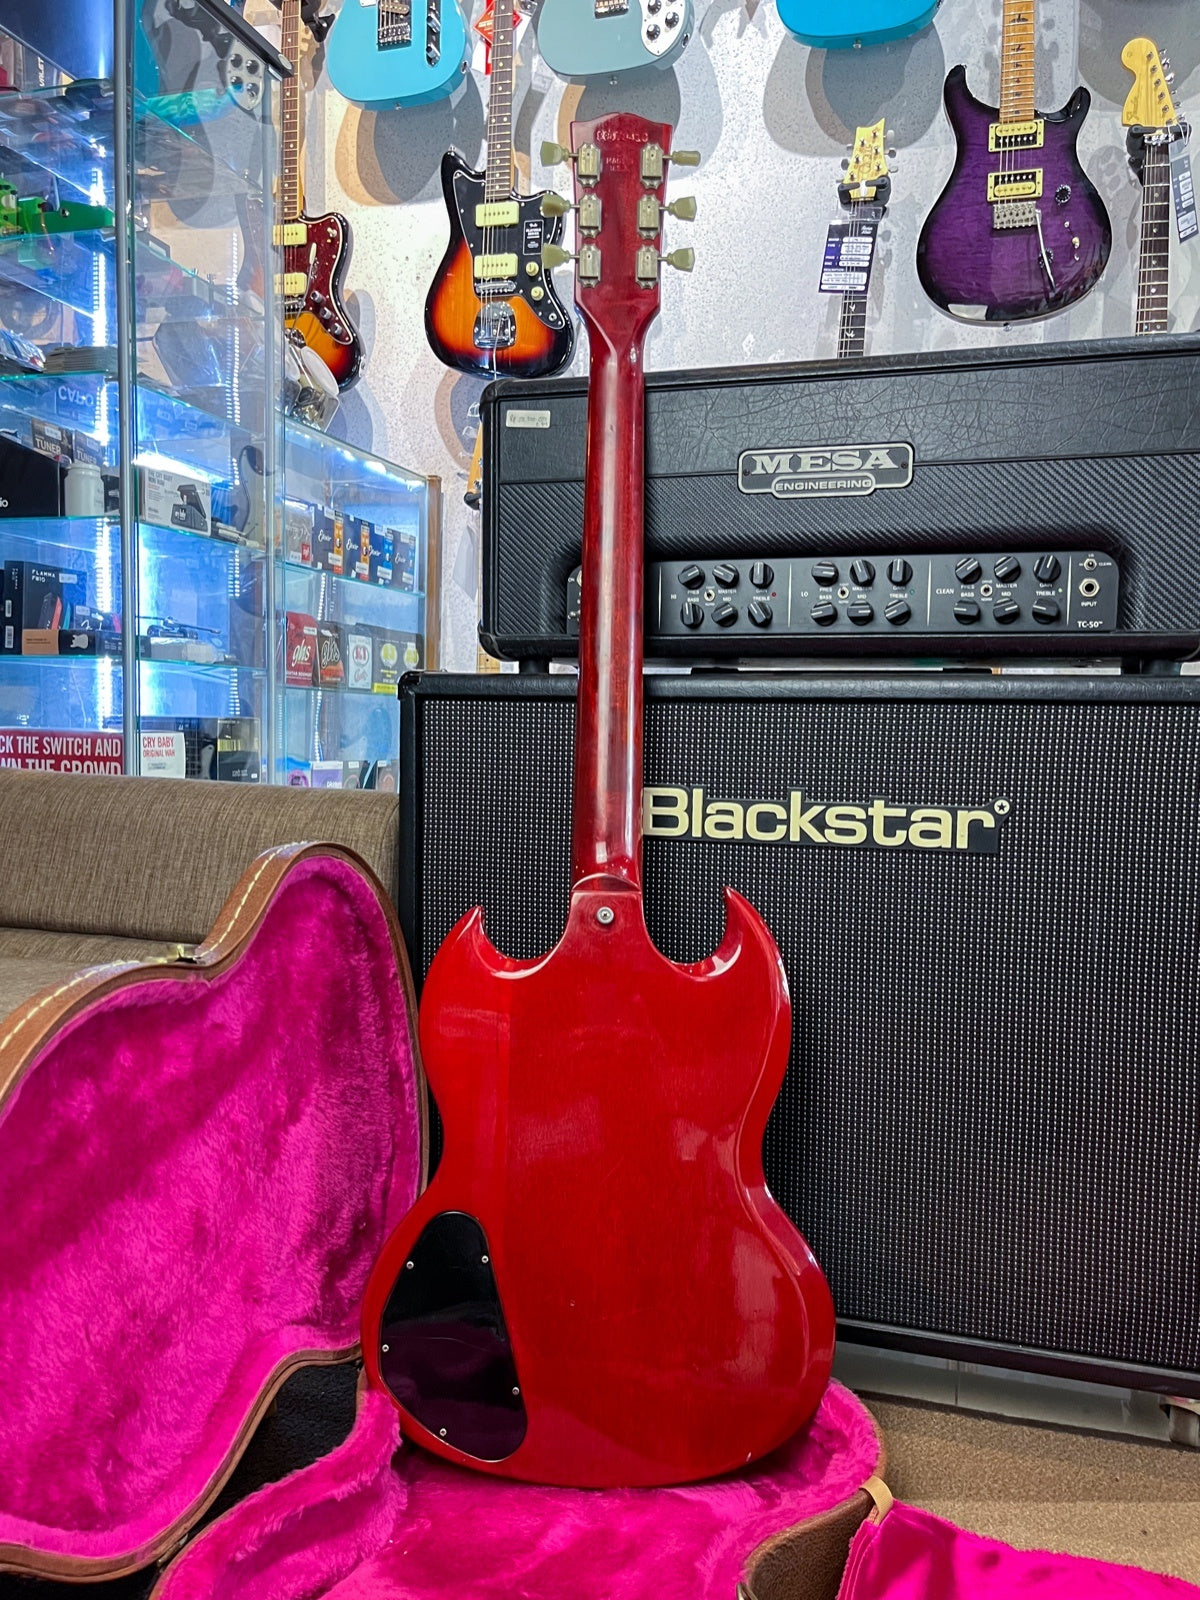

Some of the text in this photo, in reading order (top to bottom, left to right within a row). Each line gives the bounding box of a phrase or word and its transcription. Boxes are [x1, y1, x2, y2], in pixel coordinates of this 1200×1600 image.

[35, 438, 62, 454] TUNER
[76, 449, 97, 465] TUNER
[751, 449, 899, 475] MESA
[775, 479, 872, 491] ENGINEERING
[32, 569, 55, 578] FLAMMA
[291, 639, 311, 667] ghs
[16, 736, 40, 754] THE
[43, 737, 91, 756] SWITCH
[95, 738, 121, 757] AND
[142, 736, 174, 748] CRY BABY
[143, 749, 175, 758] ORIGINAL WAH
[641, 787, 995, 849] Blackstar
